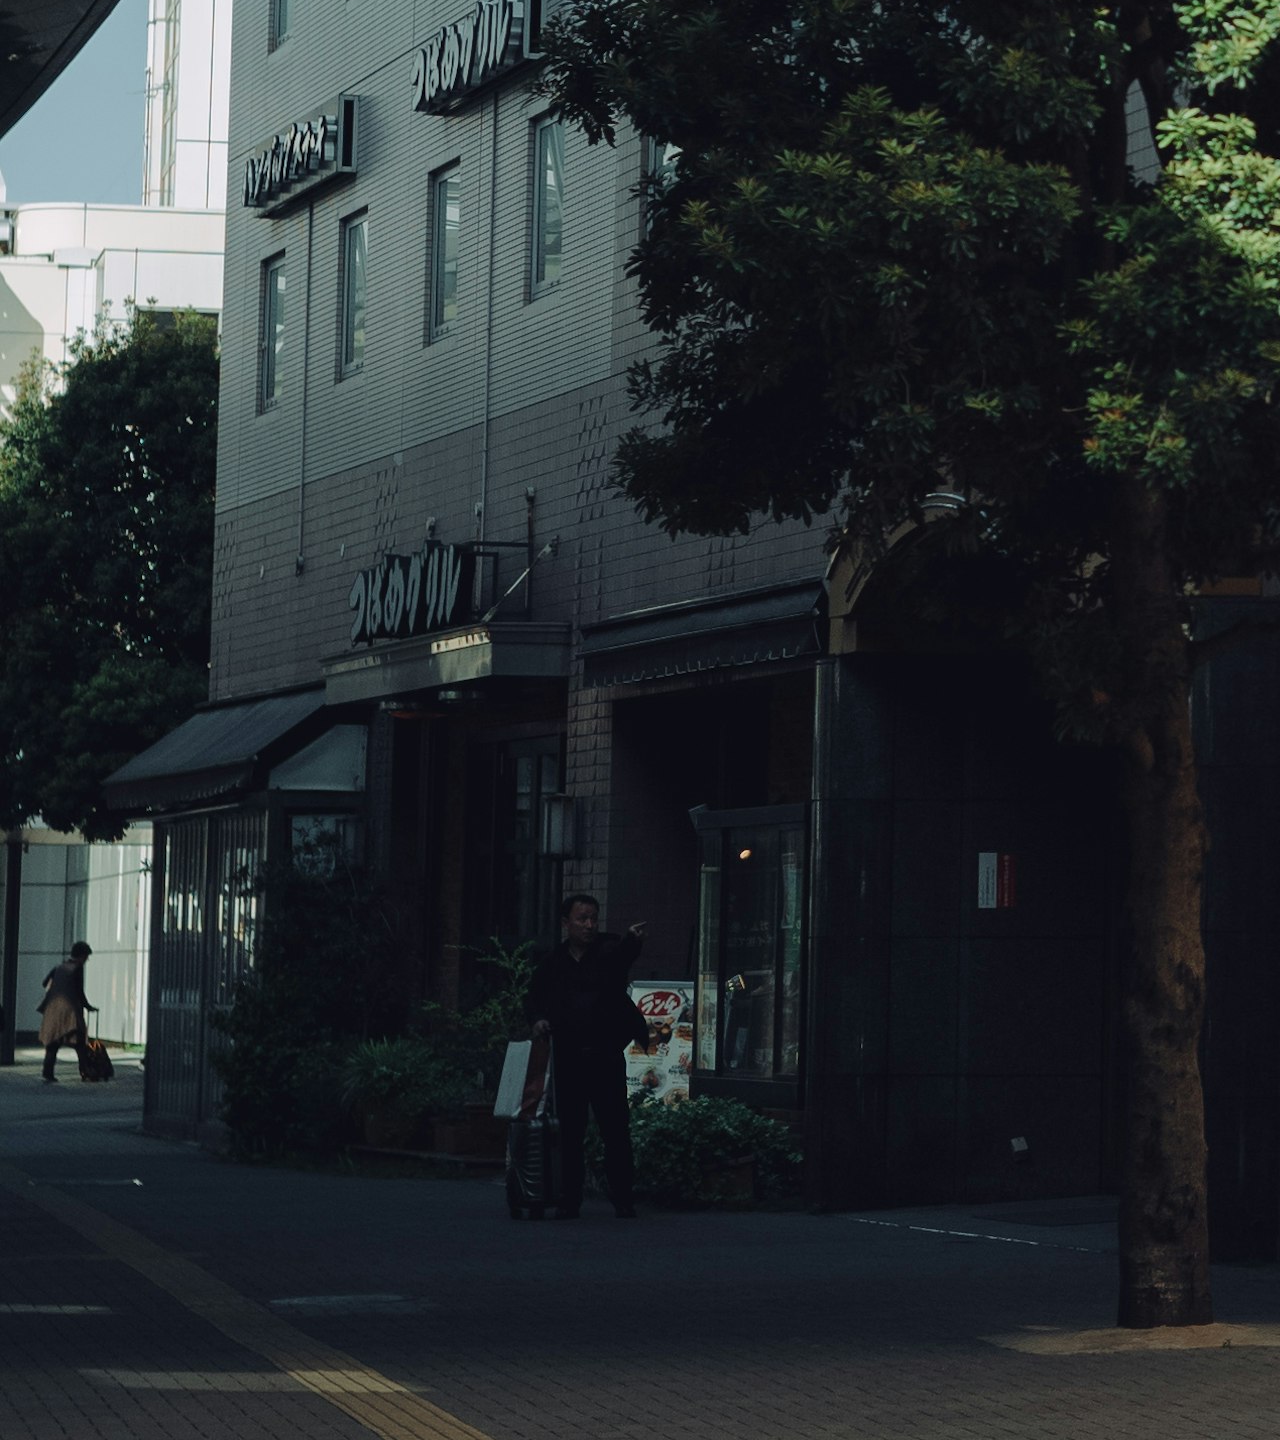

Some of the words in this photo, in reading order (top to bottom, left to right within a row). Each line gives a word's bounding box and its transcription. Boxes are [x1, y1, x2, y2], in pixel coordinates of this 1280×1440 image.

[349, 543, 470, 648] つばめグリル
